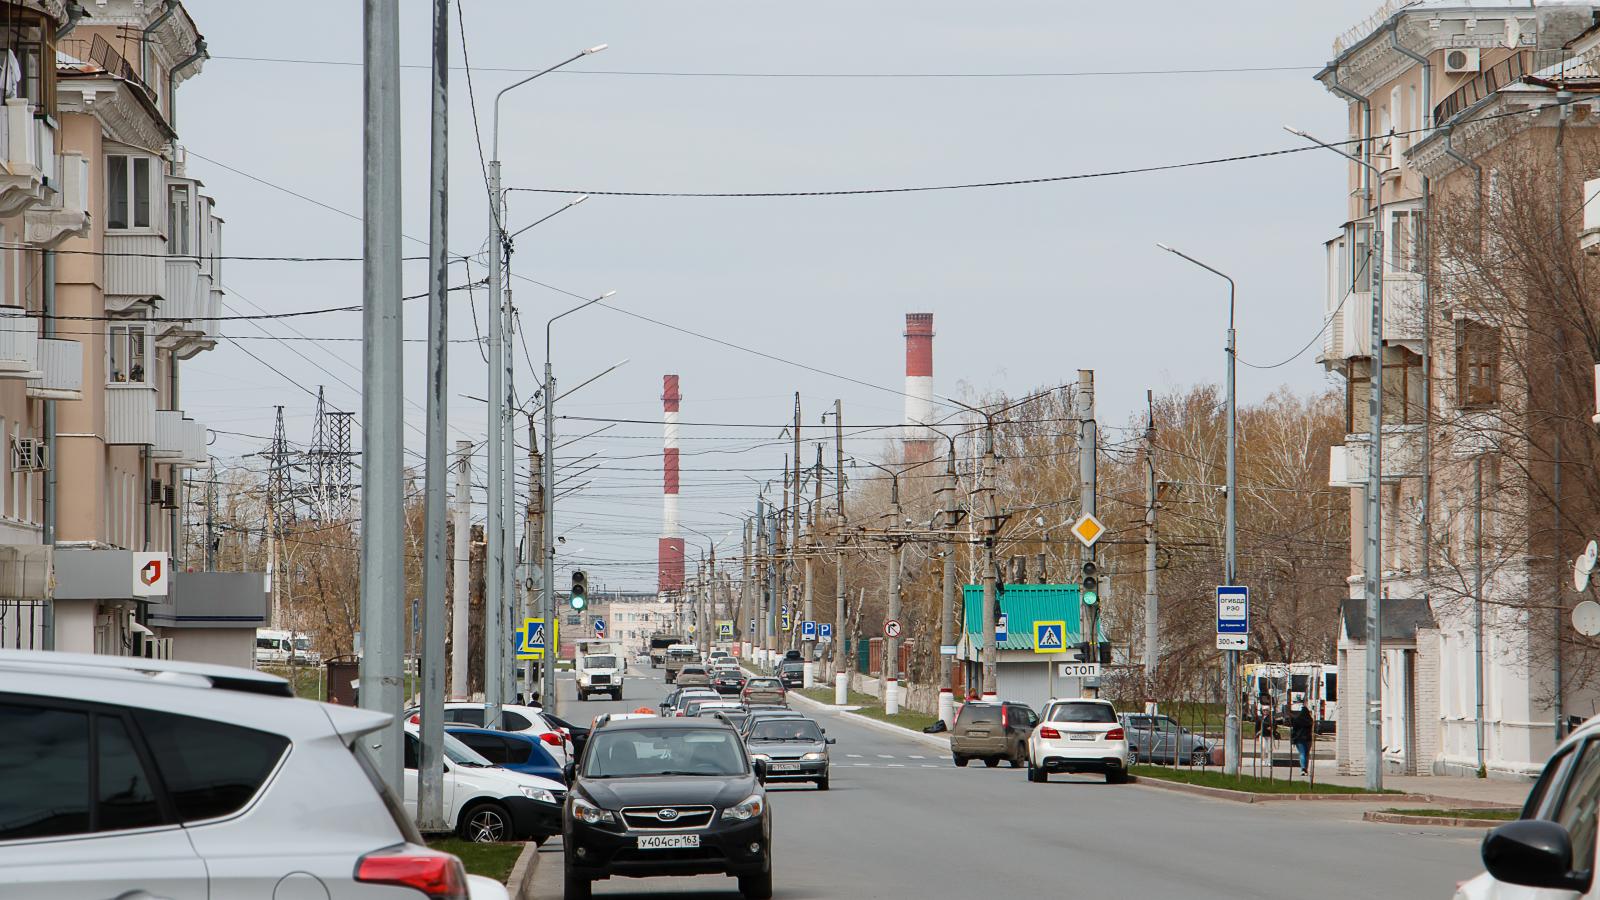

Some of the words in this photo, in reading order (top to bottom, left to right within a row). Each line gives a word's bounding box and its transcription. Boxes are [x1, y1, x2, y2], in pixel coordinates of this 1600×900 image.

[804, 622, 814, 634] P
[821, 624, 830, 636] P
[1065, 665, 1095, 675] СТОП
[682, 835, 697, 844] 163
